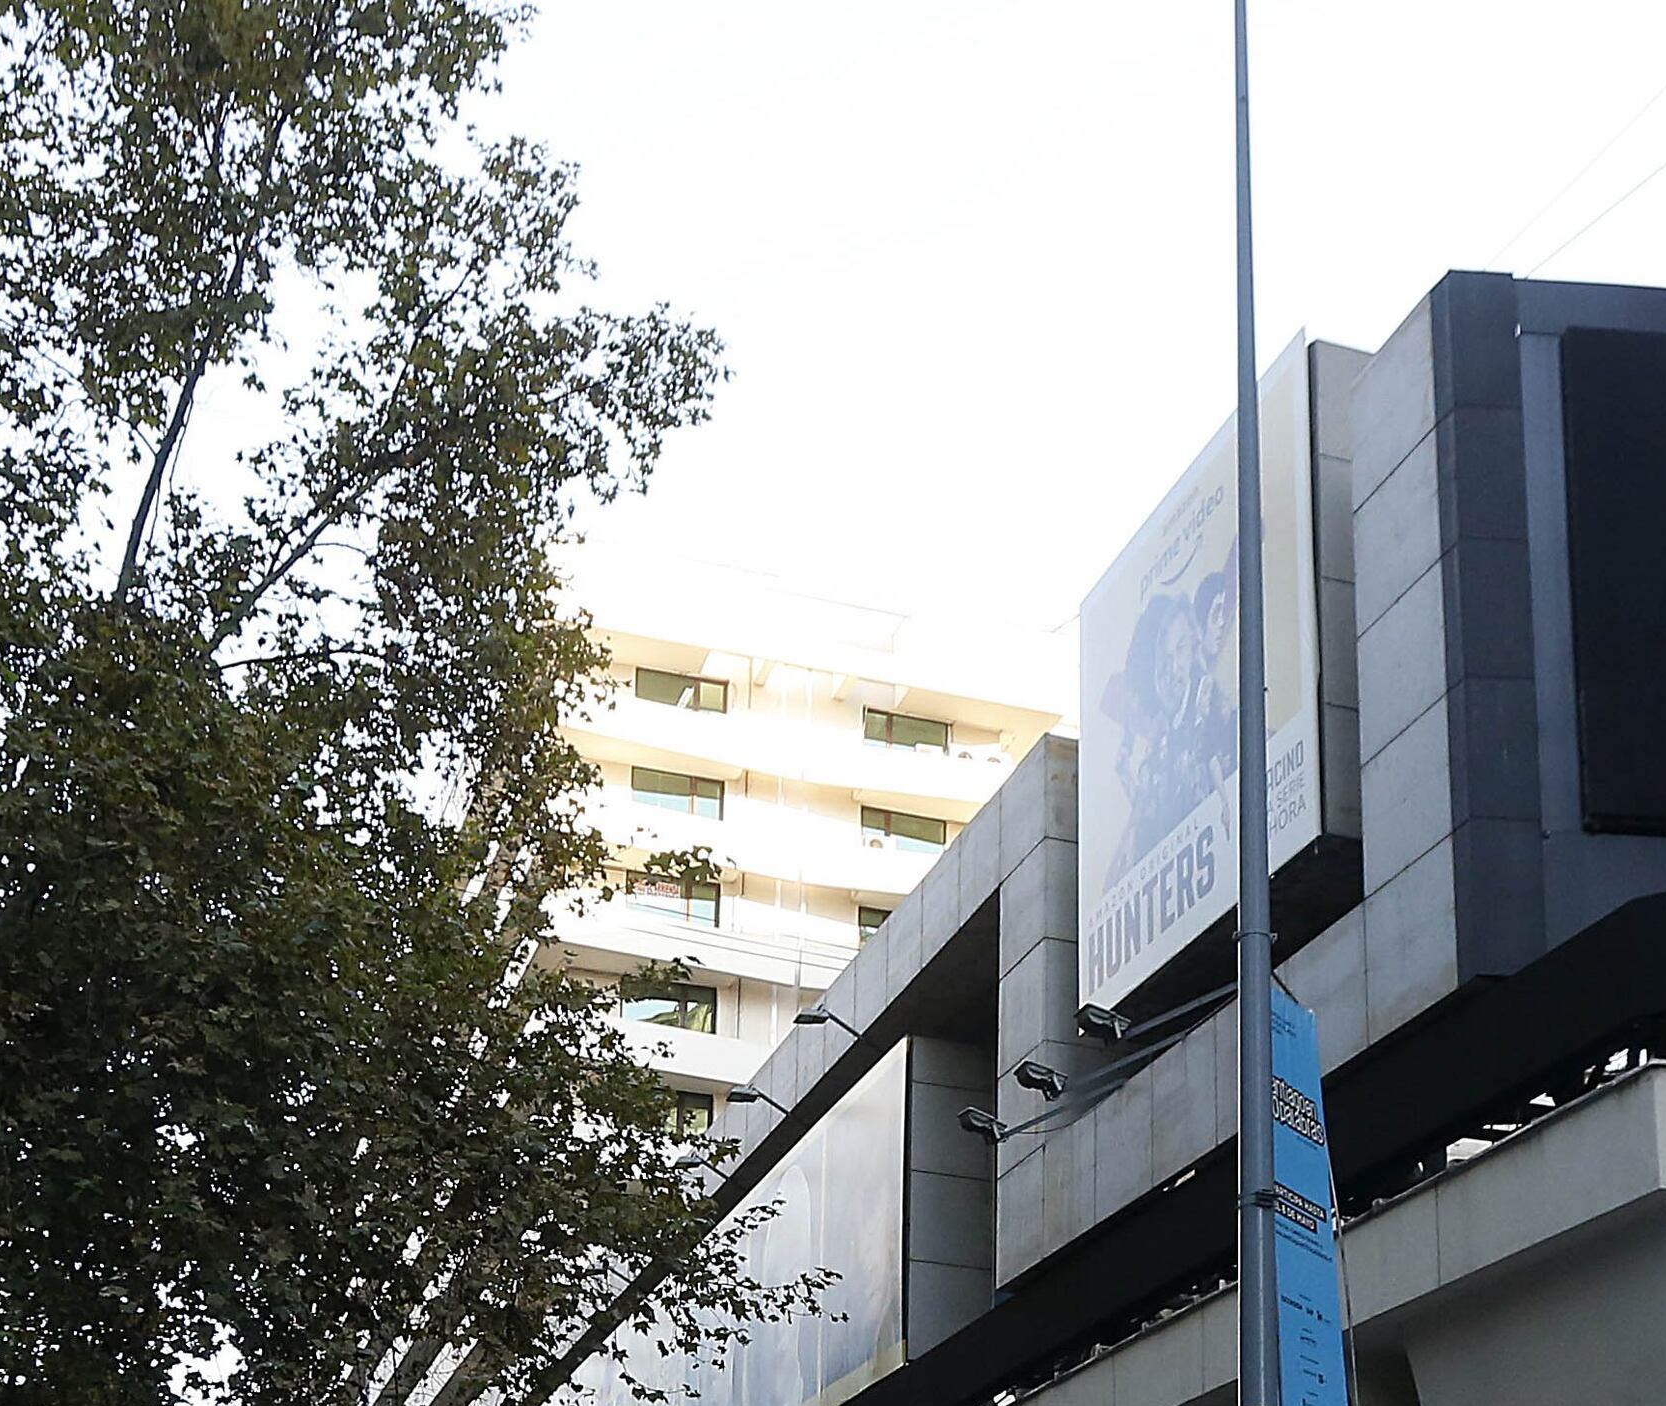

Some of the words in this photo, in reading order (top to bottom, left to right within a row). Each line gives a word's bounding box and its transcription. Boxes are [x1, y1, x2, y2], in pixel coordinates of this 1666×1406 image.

[1183, 484, 1225, 540] video
[1266, 739, 1305, 790] ACINO
[1269, 794, 1308, 840] HORA
[1087, 824, 1216, 996] HUNTERS
